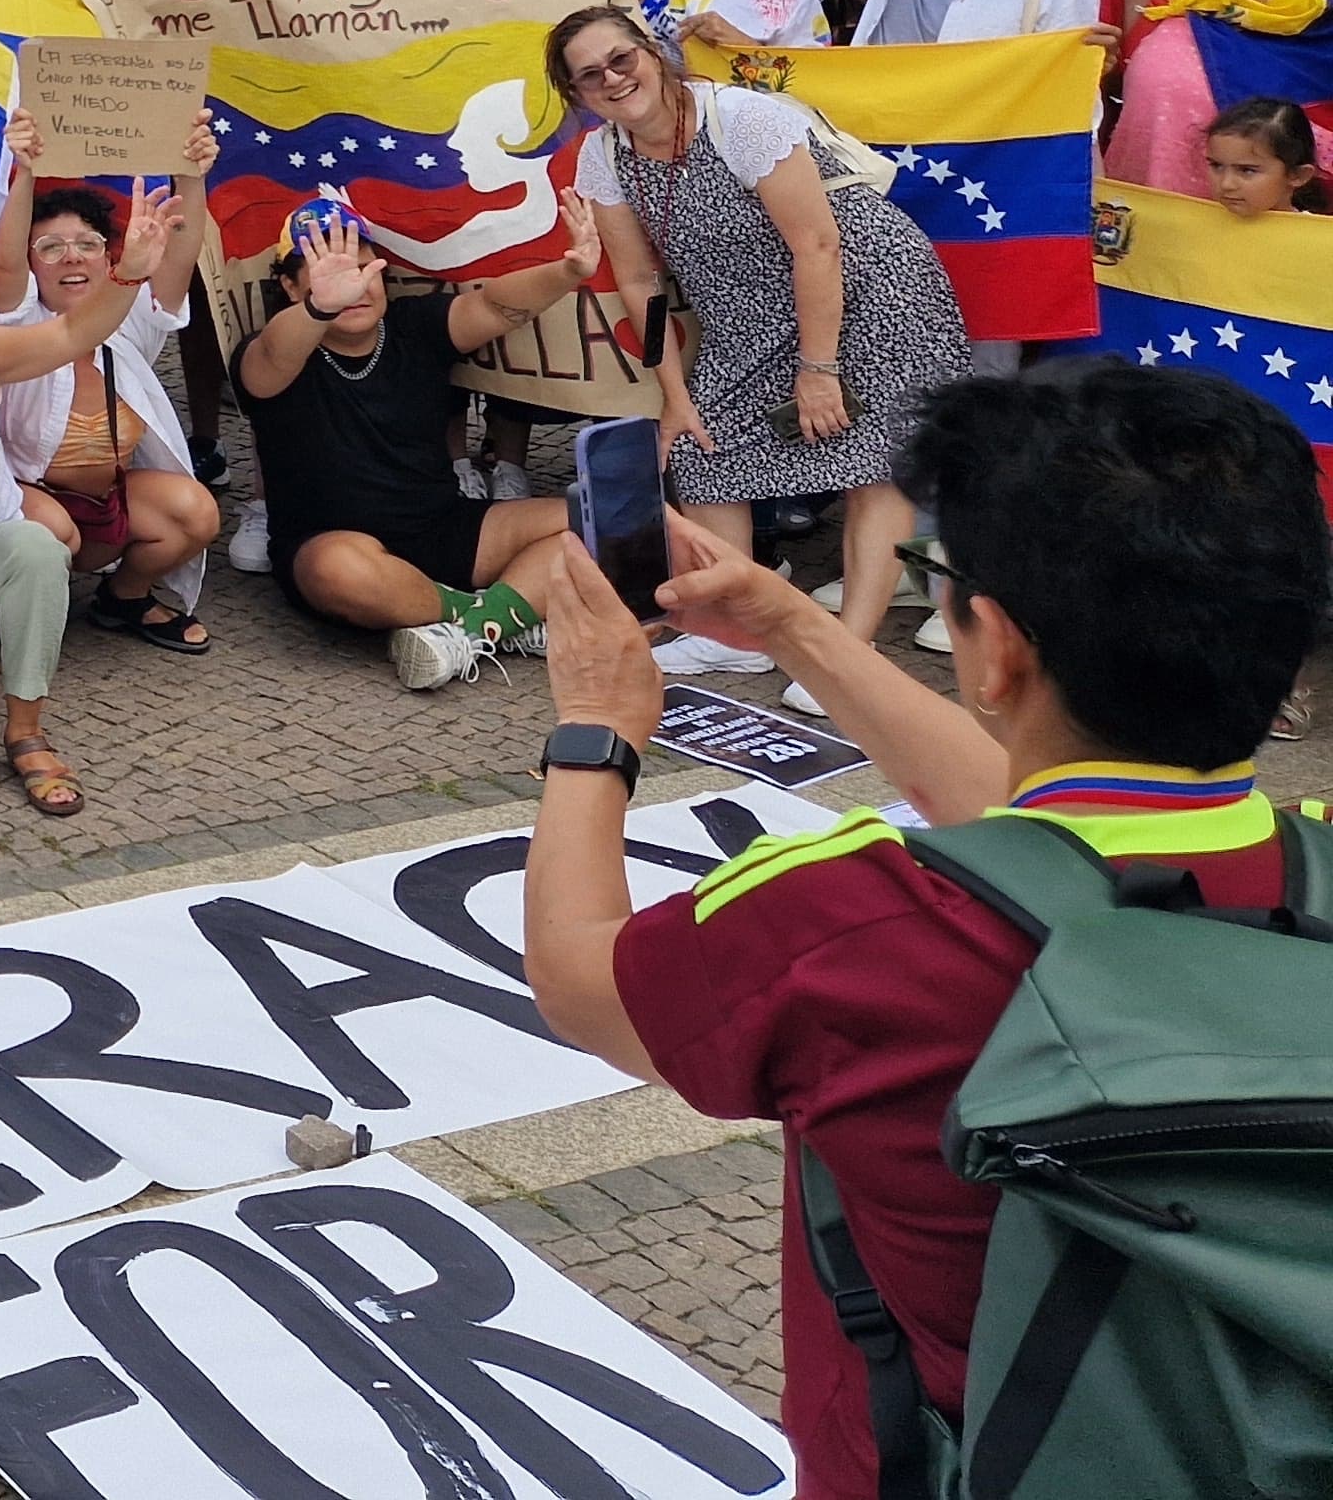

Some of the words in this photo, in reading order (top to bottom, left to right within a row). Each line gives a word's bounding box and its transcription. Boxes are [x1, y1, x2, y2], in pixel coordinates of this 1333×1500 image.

[152, 9, 215, 38] me
[37, 47, 61, 64] LA
[187, 57, 205, 71] LO
[39, 89, 61, 103] EL
[71, 94, 130, 113] MIEDO
[84, 141, 129, 159] LIBRE
[749, 738, 818, 764] 28J
